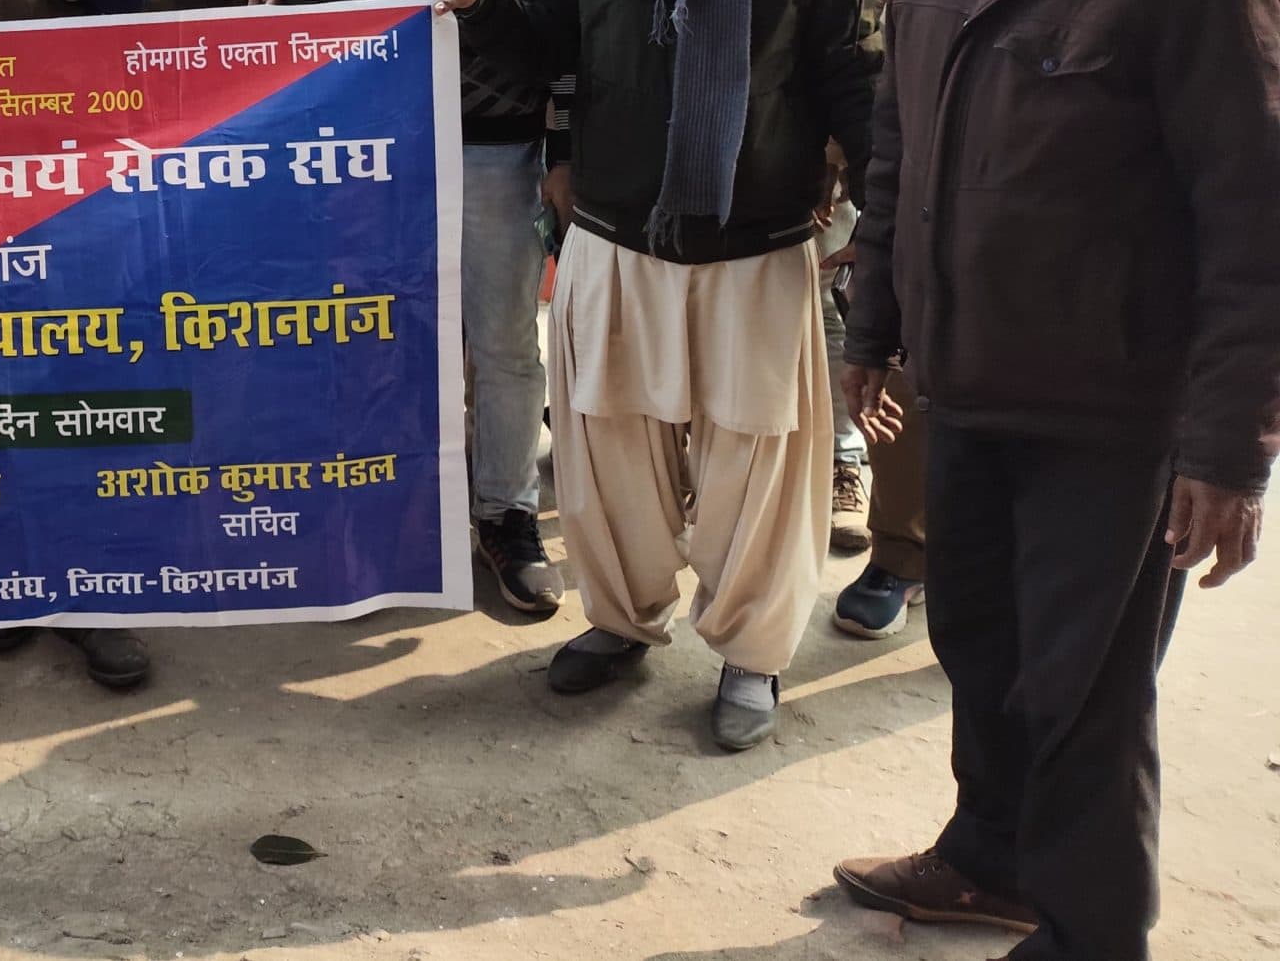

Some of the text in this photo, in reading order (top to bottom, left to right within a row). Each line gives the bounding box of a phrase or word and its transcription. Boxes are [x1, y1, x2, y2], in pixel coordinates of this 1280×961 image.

[124, 31, 401, 75] होमगार्ड एक्ता जिन्दाबाद!
[88, 91, 144, 114] 2000
[104, 138, 269, 195] सेवक
[286, 127, 396, 185] संघ
[159, 283, 395, 353] किशनगंज
[52, 399, 166, 437] सोमवार
[97, 451, 397, 502] अशोक कुमार मंडल
[220, 506, 300, 538] सचिव
